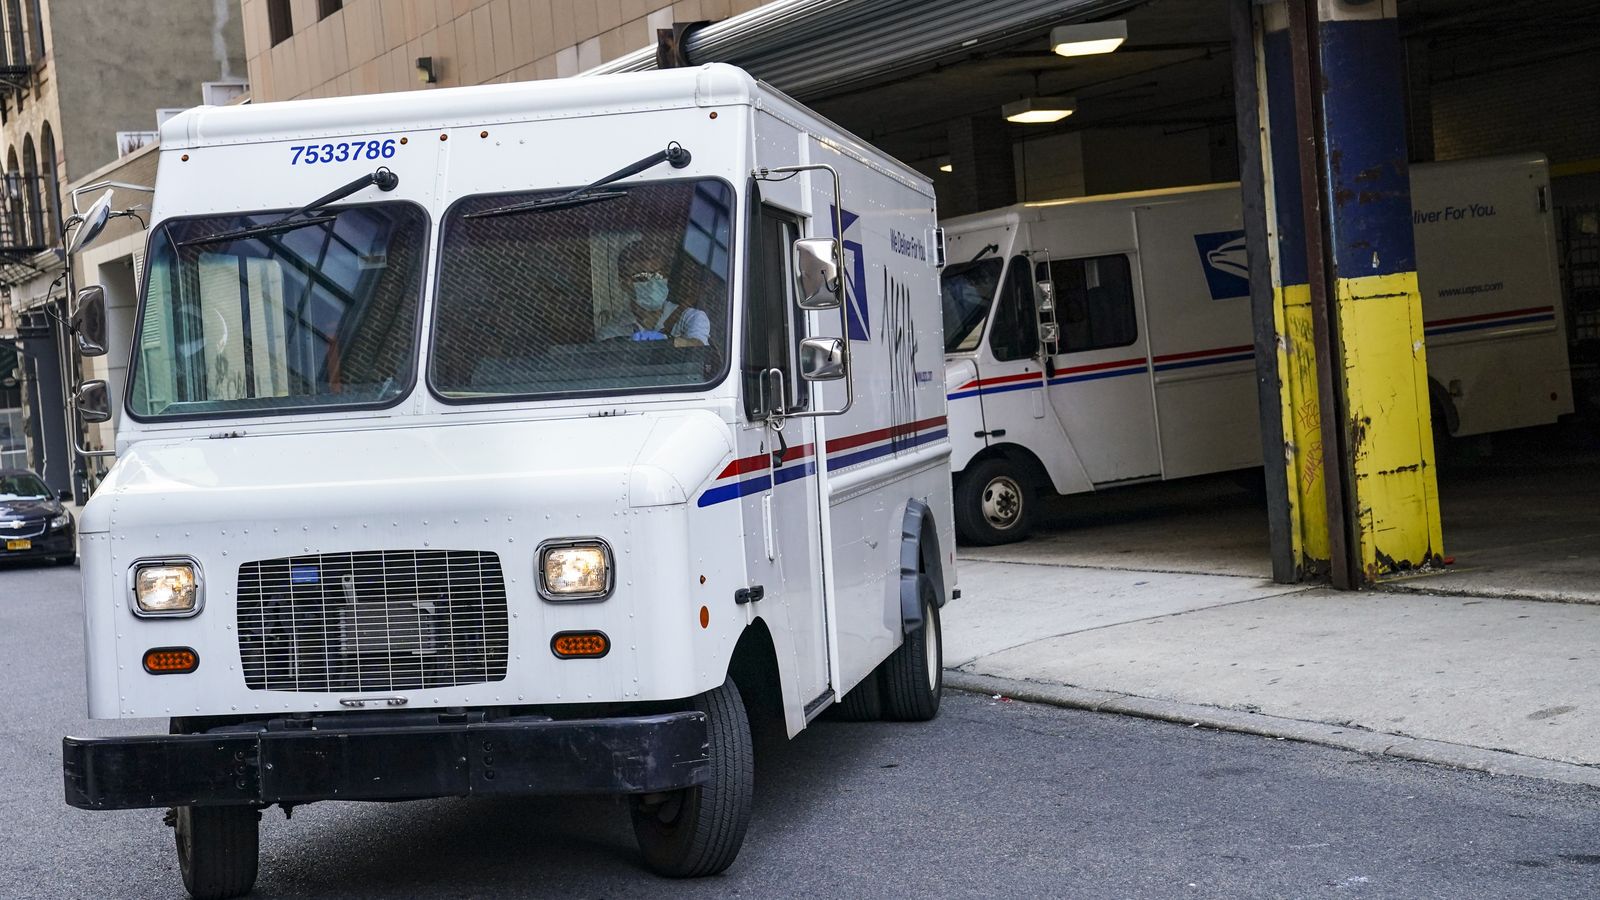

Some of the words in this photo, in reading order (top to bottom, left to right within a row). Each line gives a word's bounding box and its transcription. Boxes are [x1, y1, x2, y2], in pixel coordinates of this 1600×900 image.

[290, 139, 396, 165] 7533786
[1413, 209, 1442, 225] liver
[1444, 206, 1467, 221] For
[1468, 202, 1497, 218] You.
[890, 227, 897, 252] We
[898, 231, 911, 257] Deliver
[1439, 282, 1503, 297] www.usps.com
